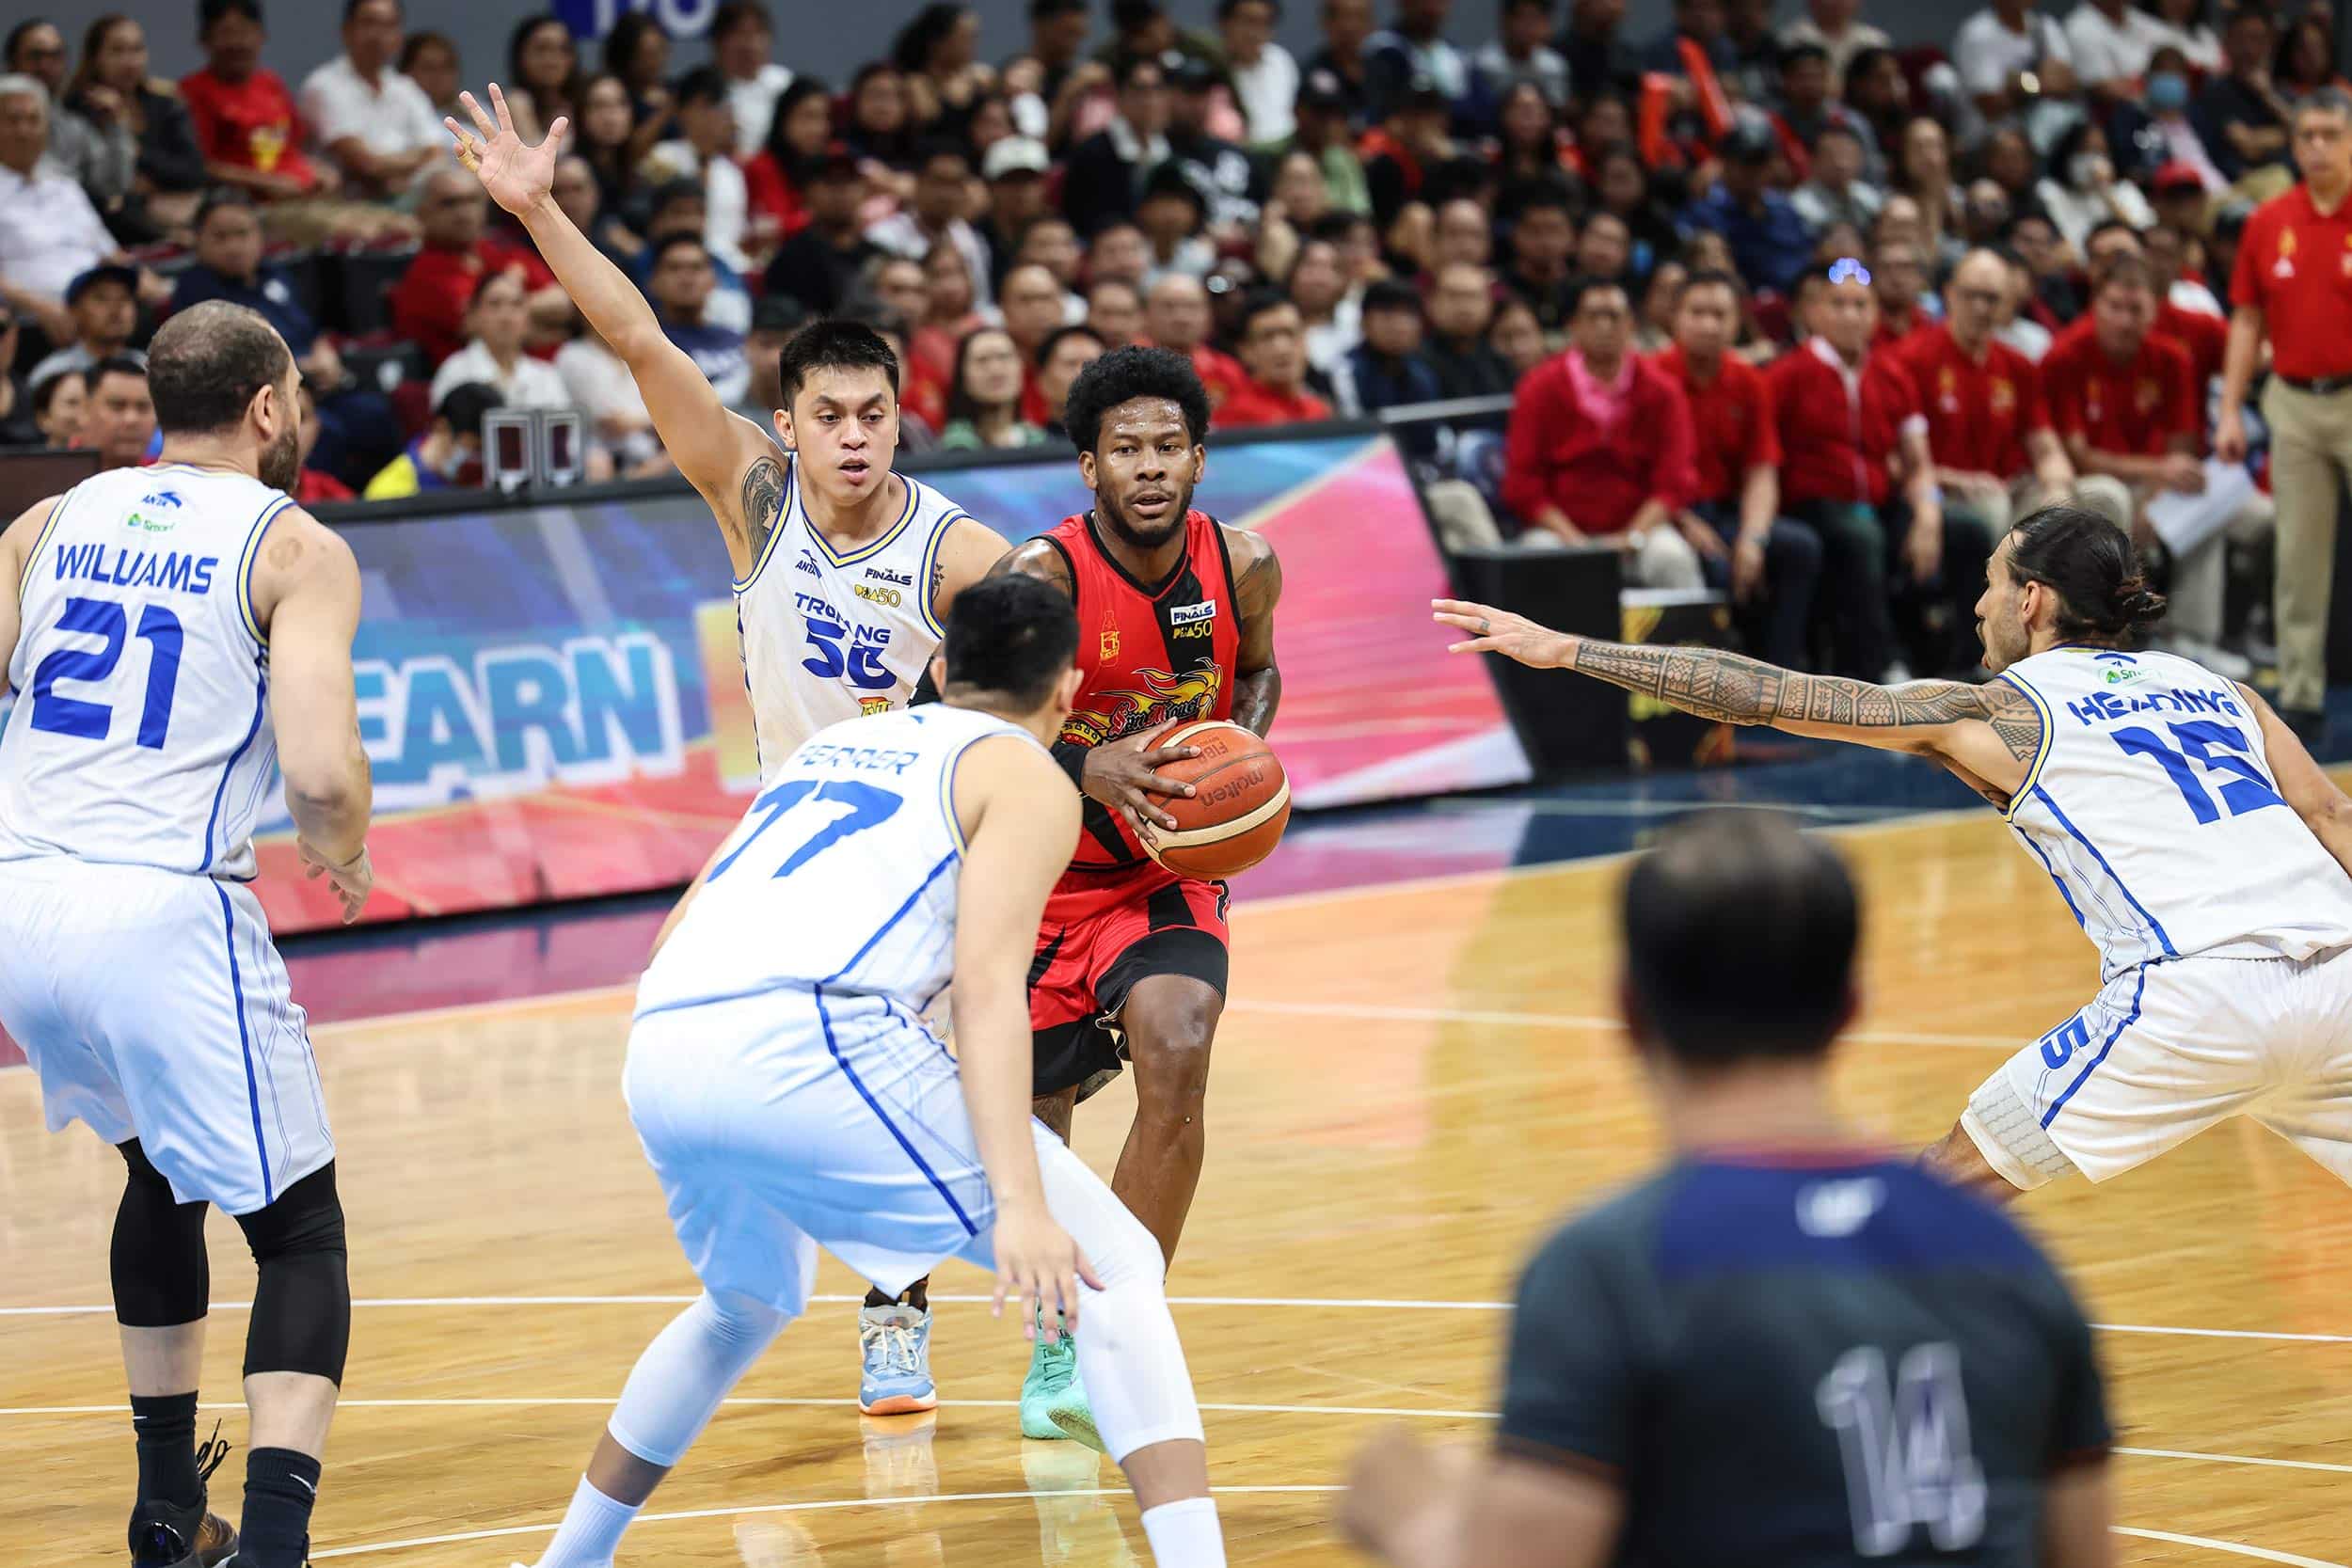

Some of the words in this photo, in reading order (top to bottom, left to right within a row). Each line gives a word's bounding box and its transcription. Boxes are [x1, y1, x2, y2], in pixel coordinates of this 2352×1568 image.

[56, 543, 219, 595] WILLIAMS
[865, 567, 913, 586] FINALS
[1173, 605, 1213, 623] FINALS
[30, 596, 183, 751] 21
[1200, 769, 1265, 807] molten
[2109, 720, 2288, 825] 15
[706, 780, 904, 883] 77
[1813, 1341, 1989, 1558] 14
